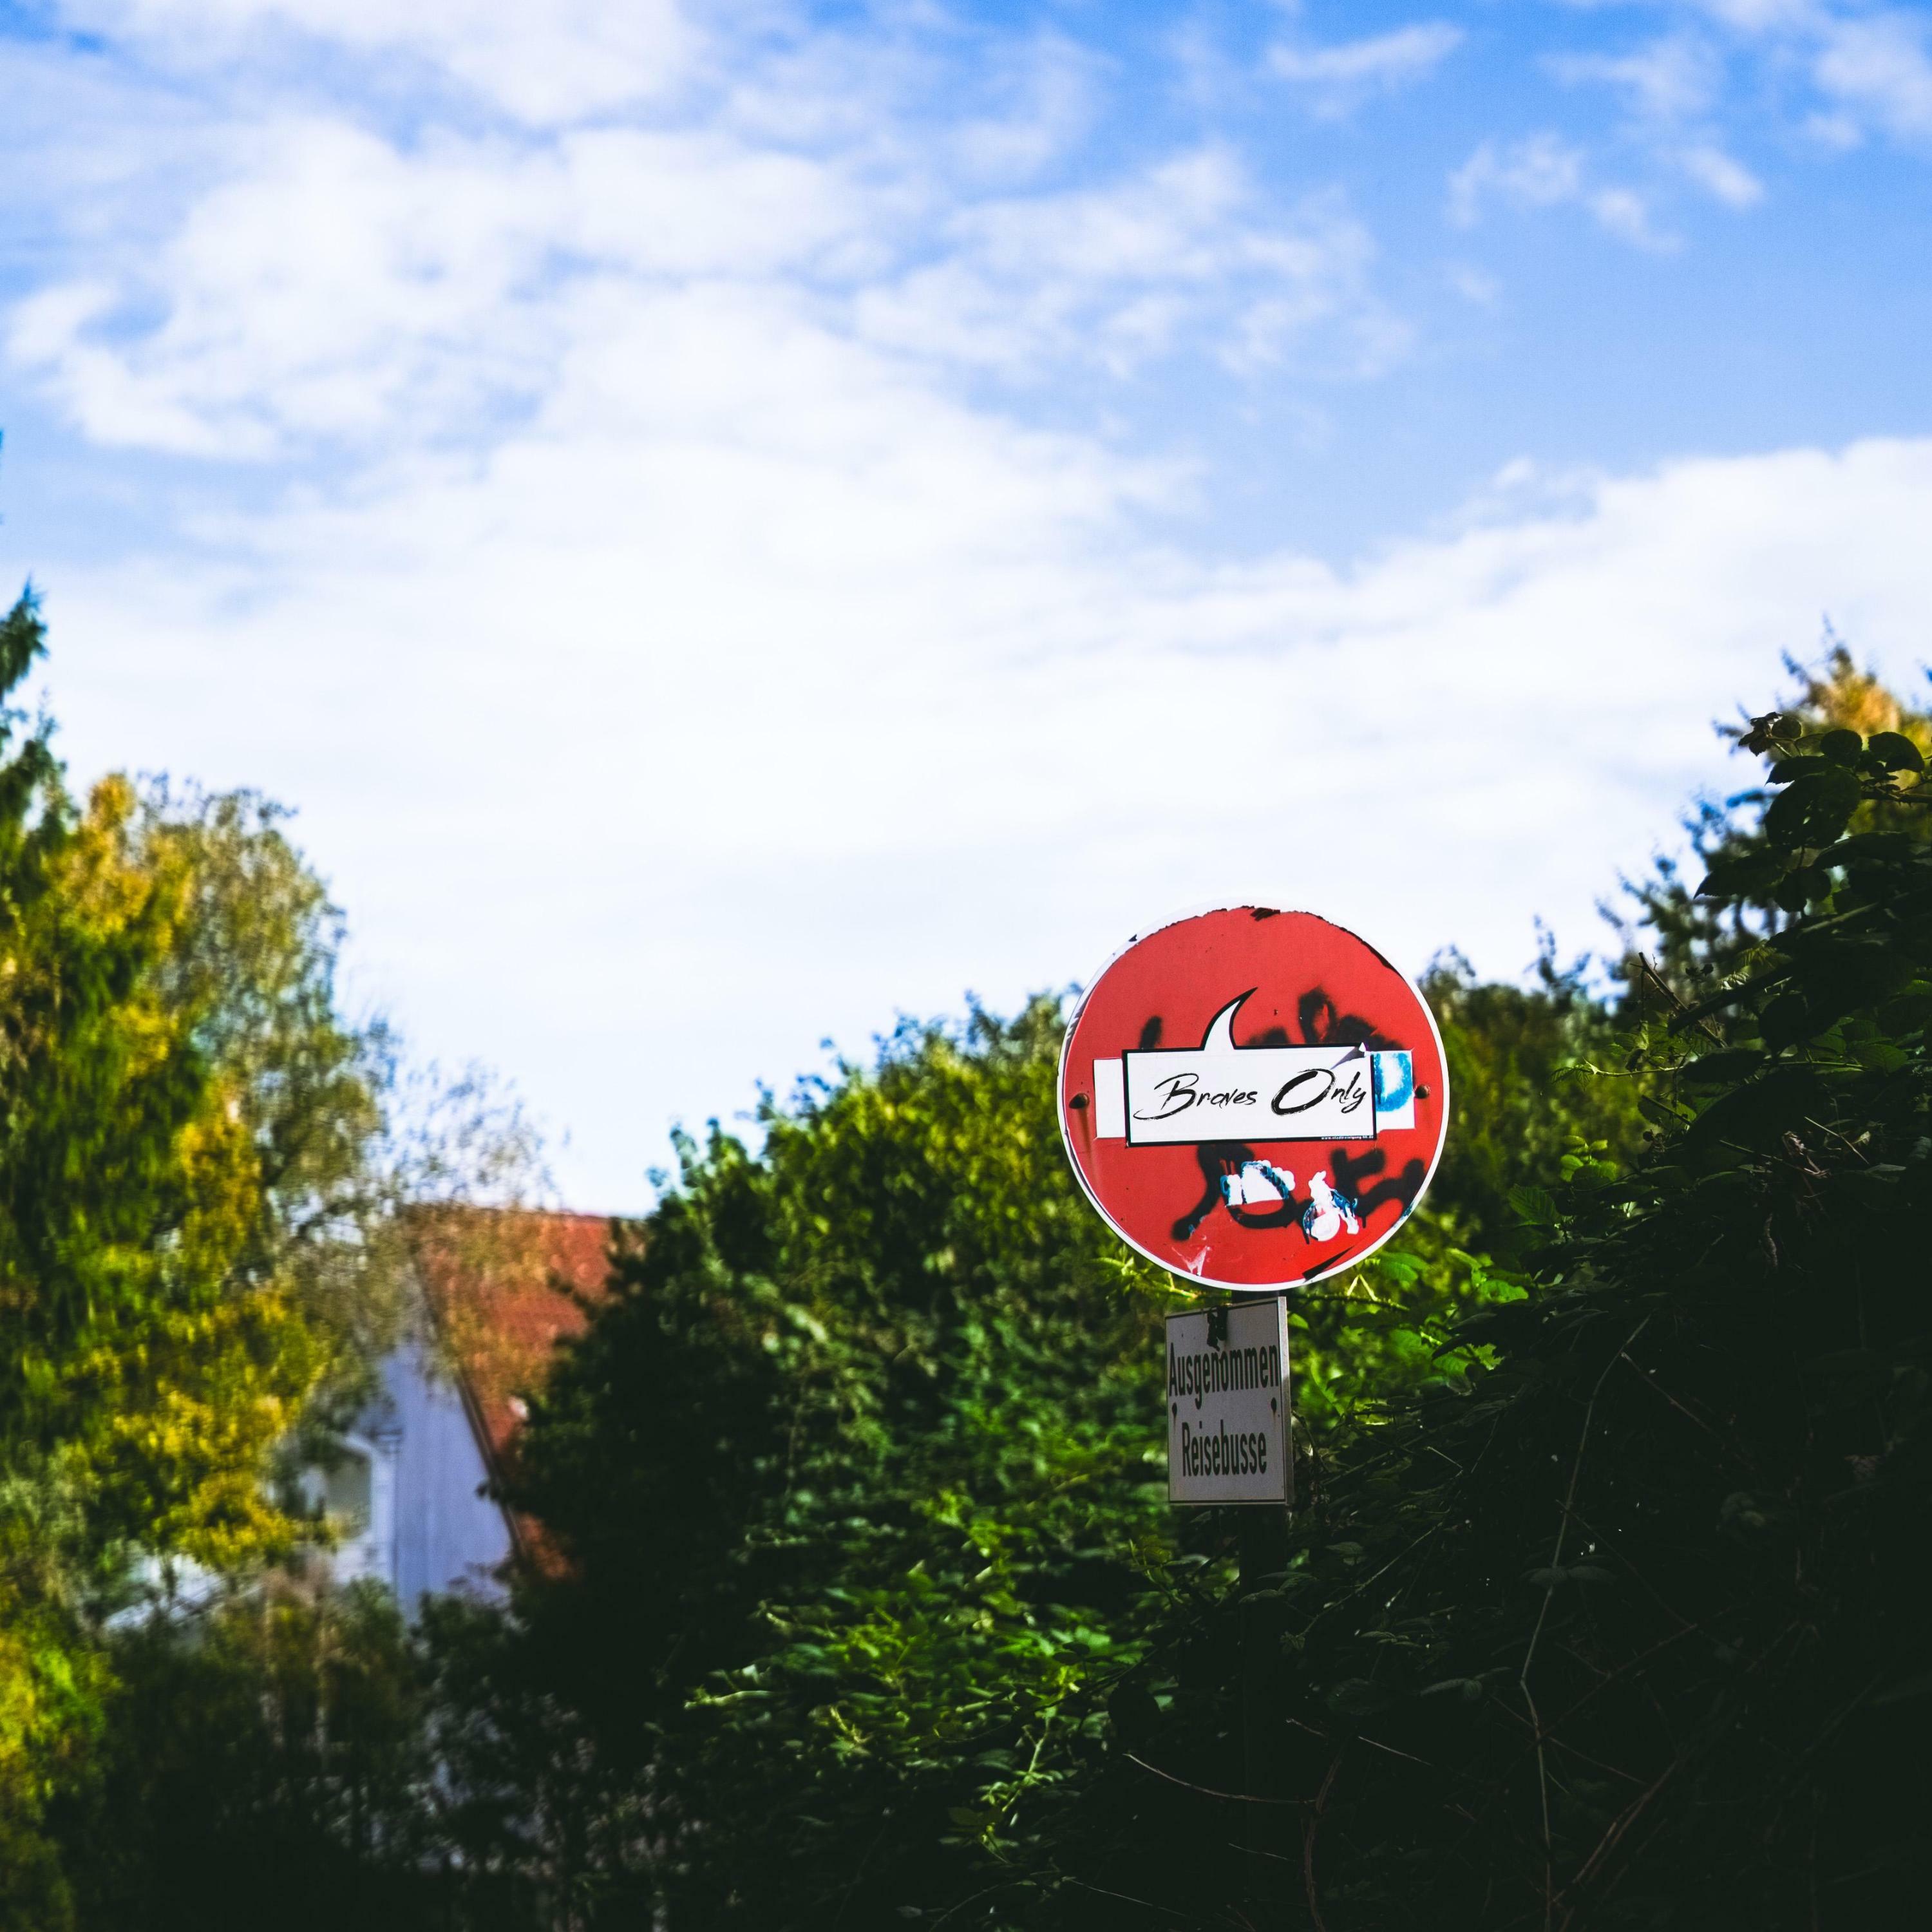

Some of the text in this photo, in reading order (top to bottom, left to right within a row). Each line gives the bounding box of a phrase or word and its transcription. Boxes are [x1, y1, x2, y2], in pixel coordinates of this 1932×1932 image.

[1133, 1068, 1367, 1121] Braves Only
[1169, 1342, 1279, 1410] Ausgenommen
[1182, 1419, 1267, 1476] Reisebusse
